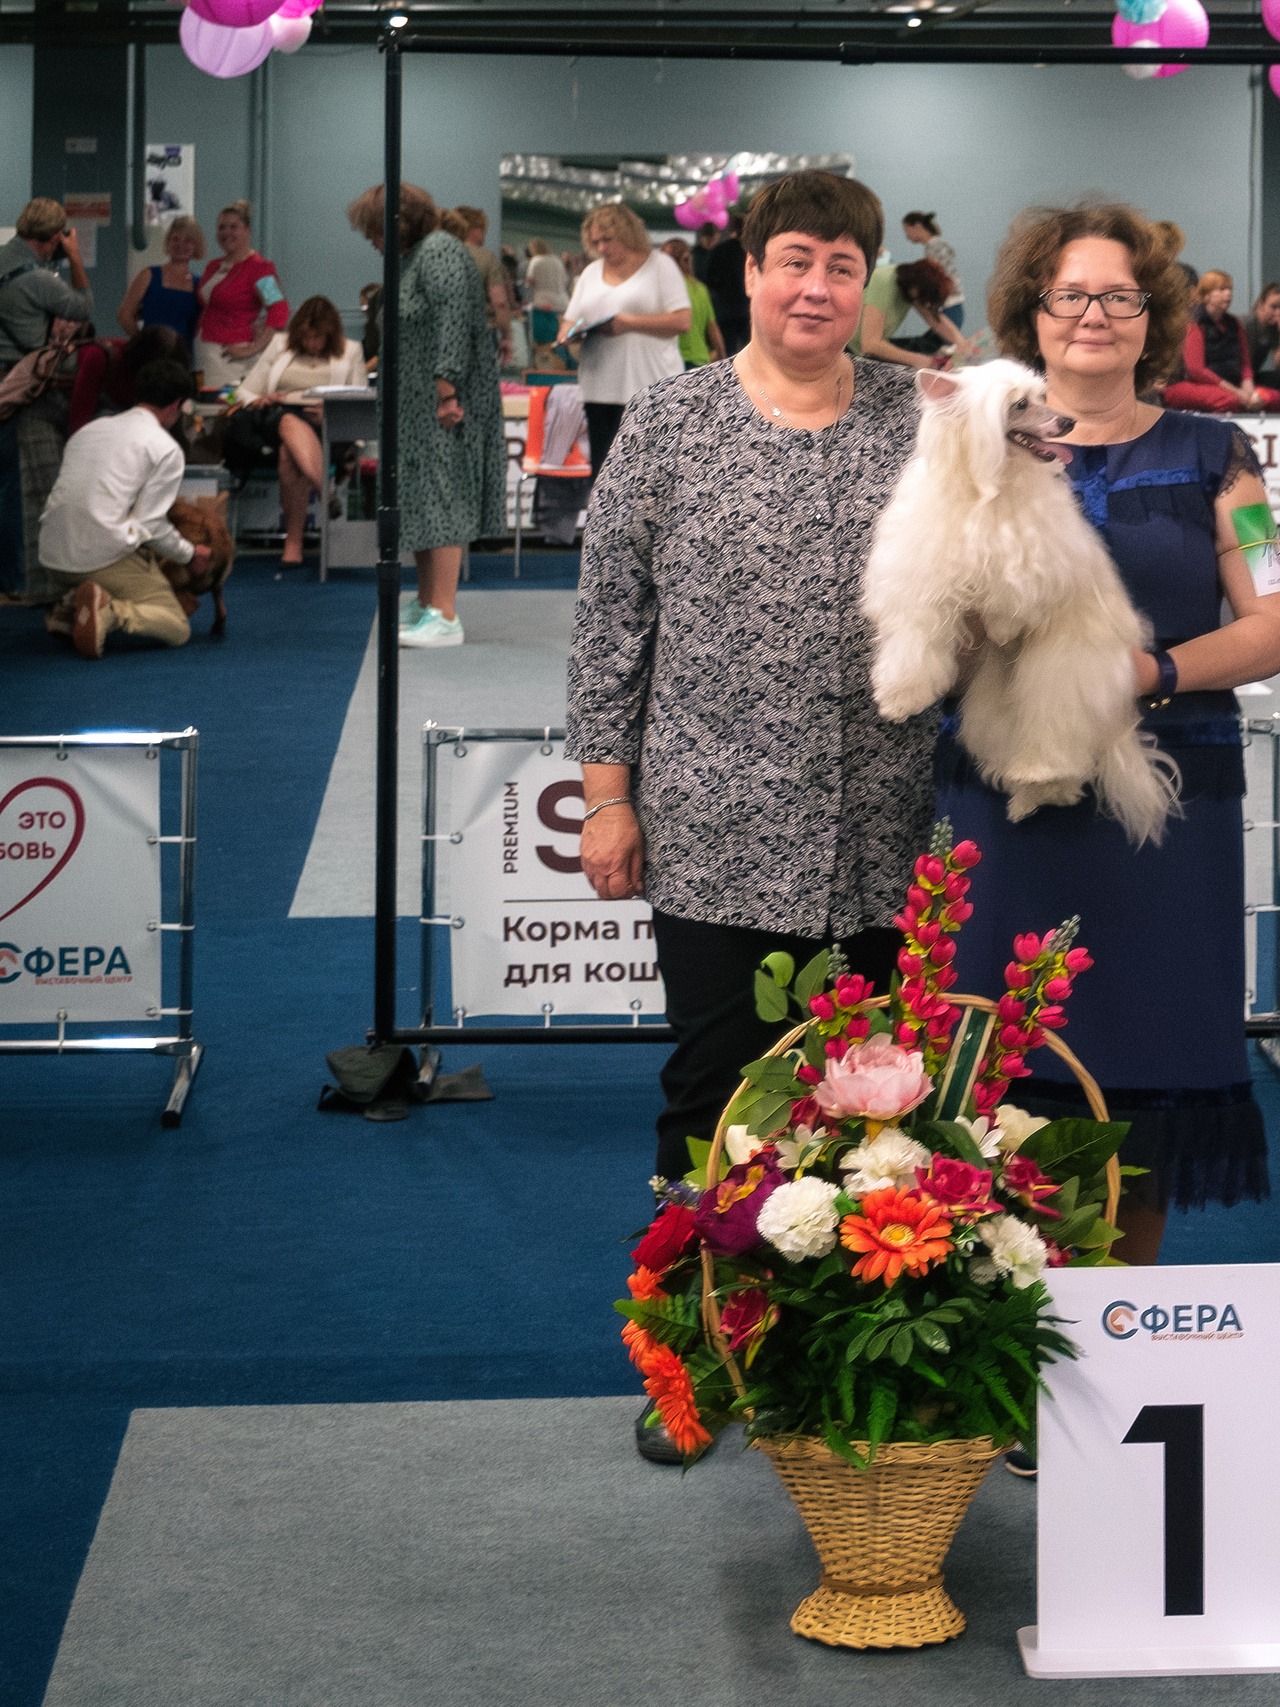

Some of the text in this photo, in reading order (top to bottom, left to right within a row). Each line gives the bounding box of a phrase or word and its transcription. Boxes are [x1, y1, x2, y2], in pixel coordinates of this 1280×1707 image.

[18, 811, 67, 830] ЭТО
[503, 782, 519, 873] PREMIUM
[535, 779, 585, 874] S
[503, 916, 620, 947] Корма
[503, 963, 571, 988] для
[1101, 1300, 1243, 1340] СФЕРА
[1120, 1403, 1205, 1617] 1
